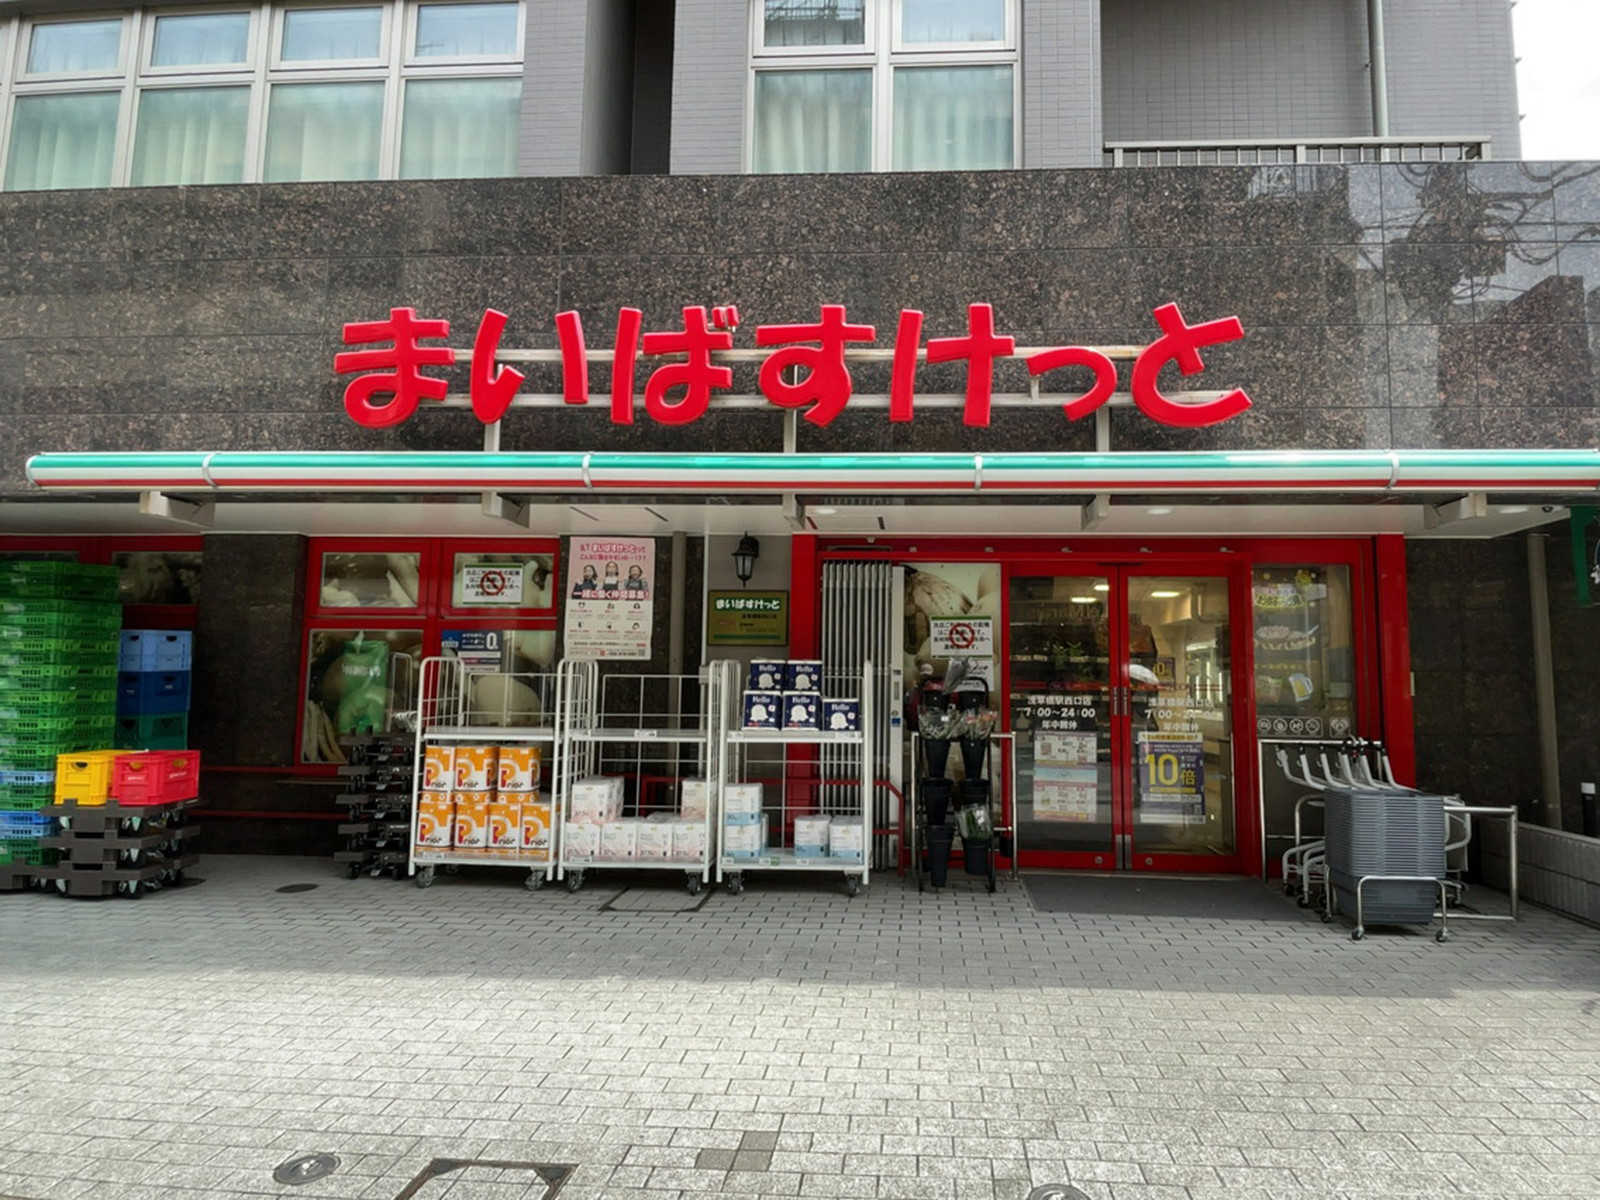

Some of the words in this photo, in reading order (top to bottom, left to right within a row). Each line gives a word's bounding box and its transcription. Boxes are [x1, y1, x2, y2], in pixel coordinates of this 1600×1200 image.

[334, 302, 1252, 428] まいばすけっと
[715, 599, 780, 610] まいばすけっと
[752, 696, 770, 704] Hello
[792, 696, 810, 704] Hello
